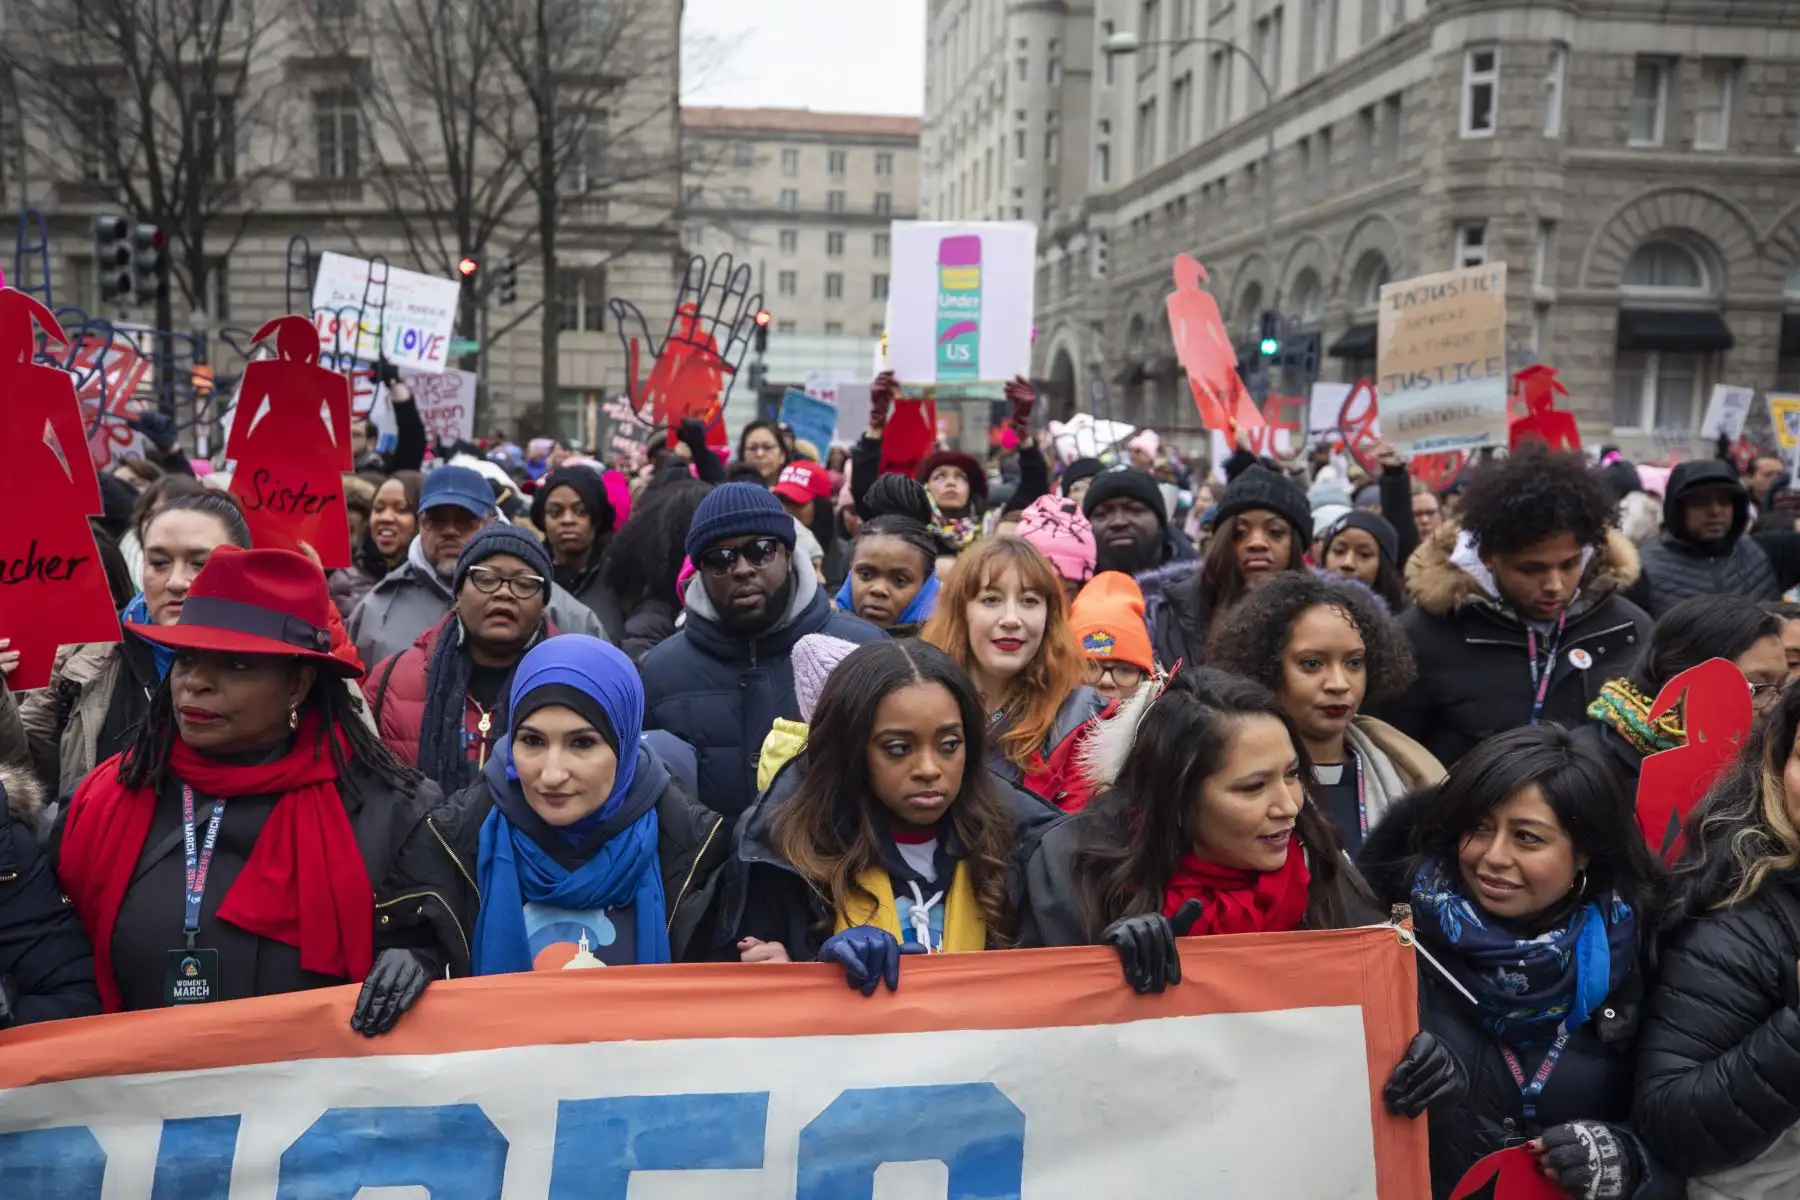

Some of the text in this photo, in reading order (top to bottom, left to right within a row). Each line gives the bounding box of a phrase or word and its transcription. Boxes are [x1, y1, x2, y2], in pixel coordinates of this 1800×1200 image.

[393, 325, 445, 361] LOVE
[946, 343, 970, 361] US
[1382, 357, 1501, 397] JUSTICE
[240, 468, 337, 514] Sister
[184, 823, 195, 855] MARCH
[204, 816, 220, 849] MARCH
[173, 986, 210, 997] MARCH
[176, 979, 207, 987] WOMEN'S
